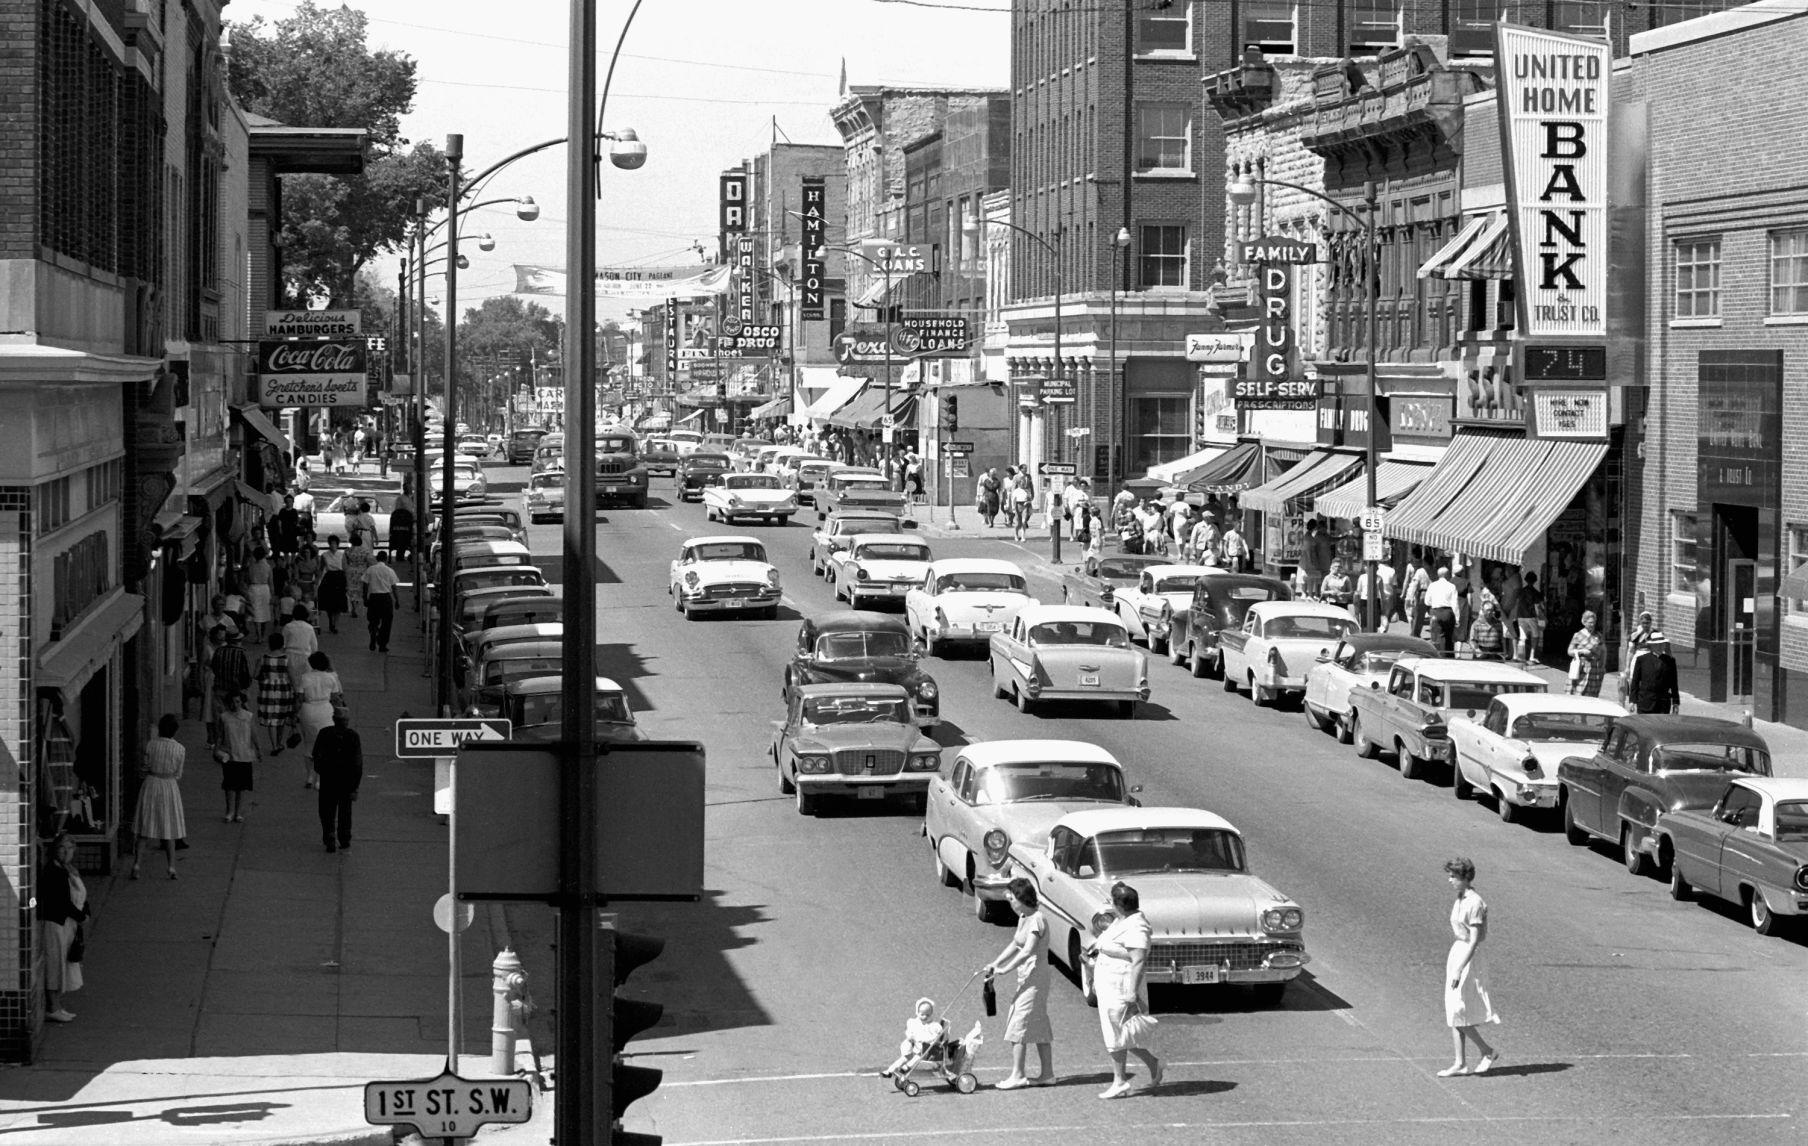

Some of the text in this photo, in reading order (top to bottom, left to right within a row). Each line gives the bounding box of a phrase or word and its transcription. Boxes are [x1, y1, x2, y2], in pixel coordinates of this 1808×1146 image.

[1515, 54, 1600, 80] UNITED
[1523, 87, 1596, 113] HOME
[1540, 121, 1586, 290] BANK
[807, 191, 820, 303] HAMILTON
[1245, 246, 1309, 261] FAMILY
[873, 259, 925, 271] LOANS
[626, 271, 642, 281] CITY
[741, 241, 752, 320] WALKER
[1557, 293, 1571, 303] &
[279, 313, 346, 323] Delicious
[1535, 305, 1600, 321] TRUST CO.
[904, 320, 965, 328] HOUSEHOLD
[1266, 268, 1286, 375] DRUG
[269, 324, 355, 335] HAMBURGERS
[743, 326, 779, 337] OSCO
[920, 329, 965, 337] FINANCE
[668, 298, 676, 389] ESTAURANT
[737, 338, 776, 348] DRUG
[899, 331, 919, 349] HFC
[920, 339, 965, 350] LOANS
[841, 337, 895, 360] Rexa
[268, 343, 356, 371] Coca-Cola
[1542, 350, 1583, 376] 74
[1235, 382, 1317, 397] SELF-SERV.
[275, 394, 337, 404] CANDIES
[1237, 400, 1316, 410] PRESCRIPTIONS
[1206, 482, 1250, 492] CANDY
[1365, 518, 1380, 528] 65
[409, 731, 484, 746] ONE WAY
[378, 1088, 517, 1116] 1ST ST. S.W.
[441, 1121, 456, 1132] 10
